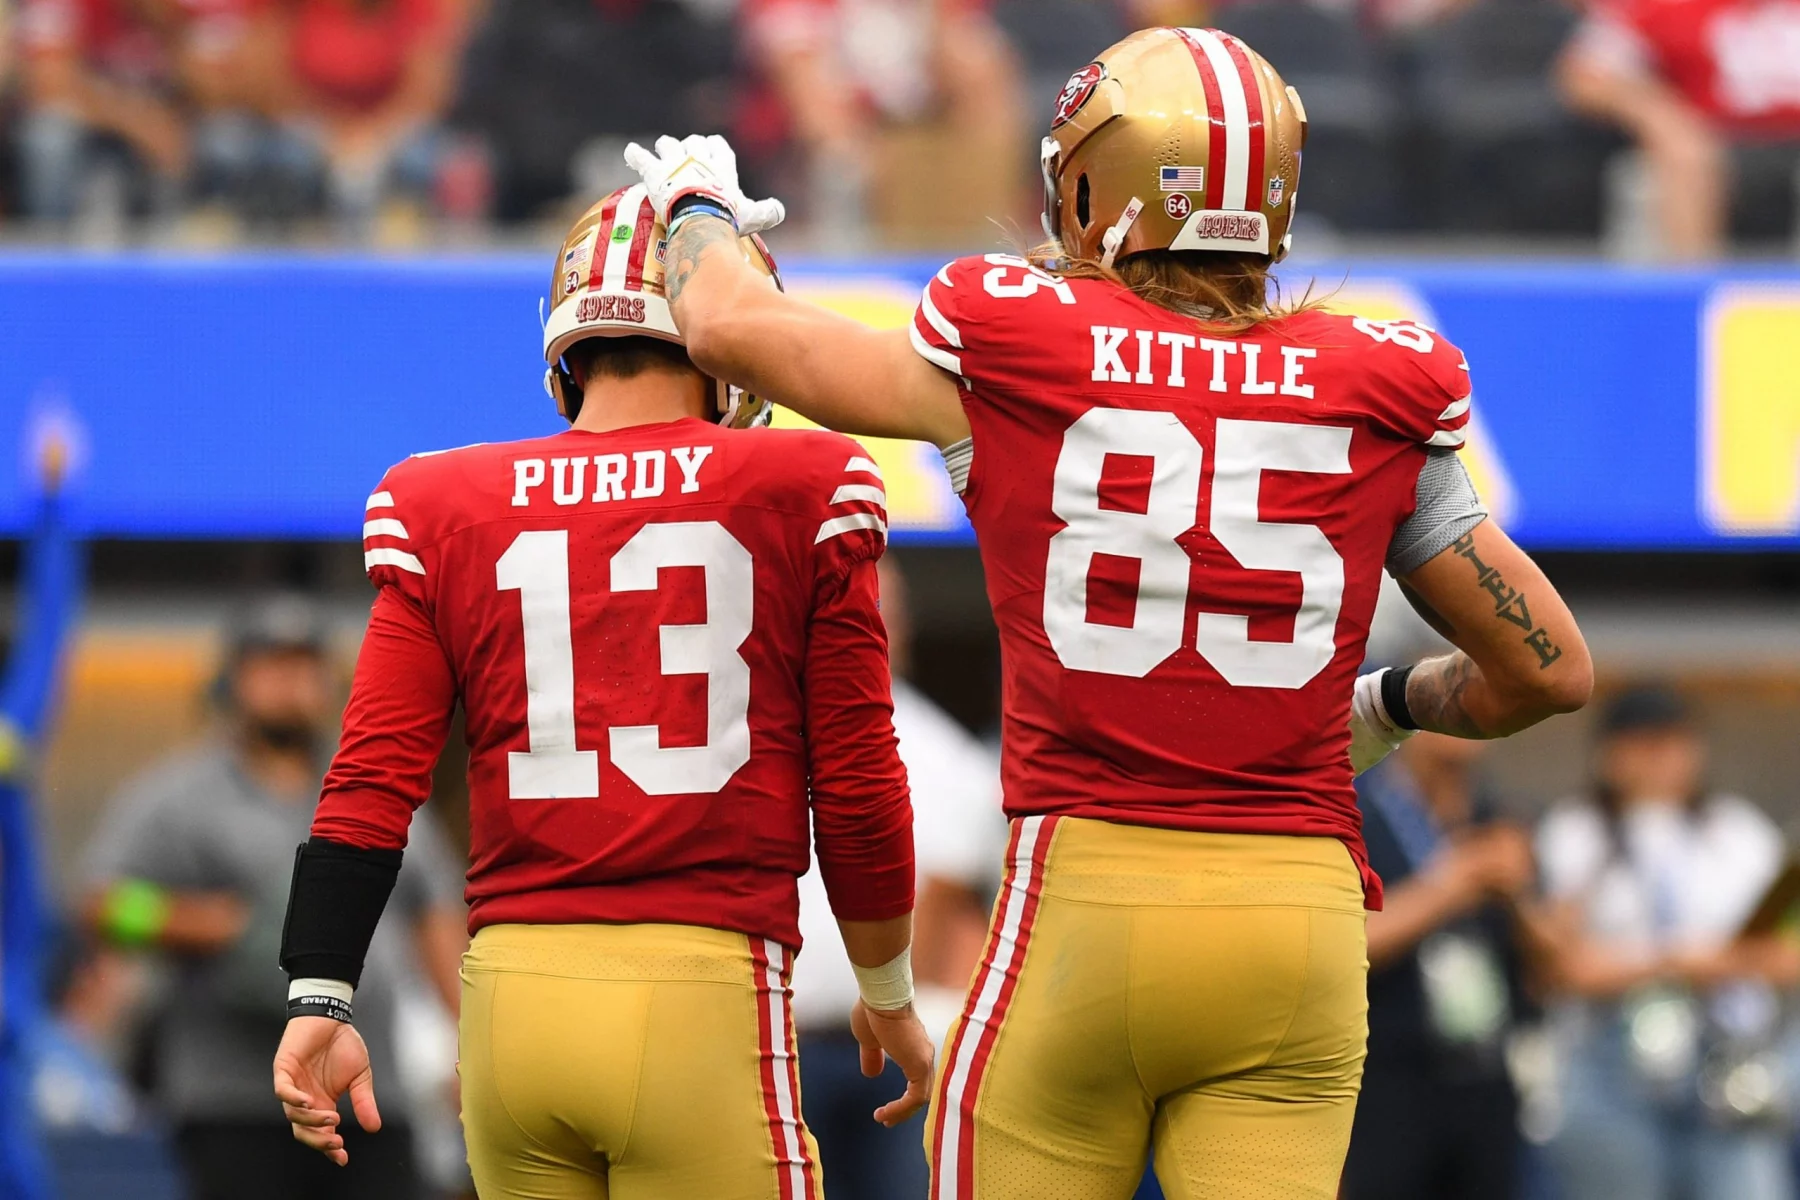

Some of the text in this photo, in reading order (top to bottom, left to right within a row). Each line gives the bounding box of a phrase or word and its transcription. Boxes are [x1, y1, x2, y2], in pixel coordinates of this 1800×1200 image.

[1125, 206, 1137, 220] 85
[1166, 198, 1188, 215] 64
[1195, 215, 1262, 241] 49ERS
[564, 274, 579, 292] 64
[575, 295, 646, 323] 49ERS
[1090, 325, 1317, 400] KITTLE
[511, 445, 714, 507] PURDY
[1043, 407, 1354, 689] 85
[495, 520, 754, 800] 13
